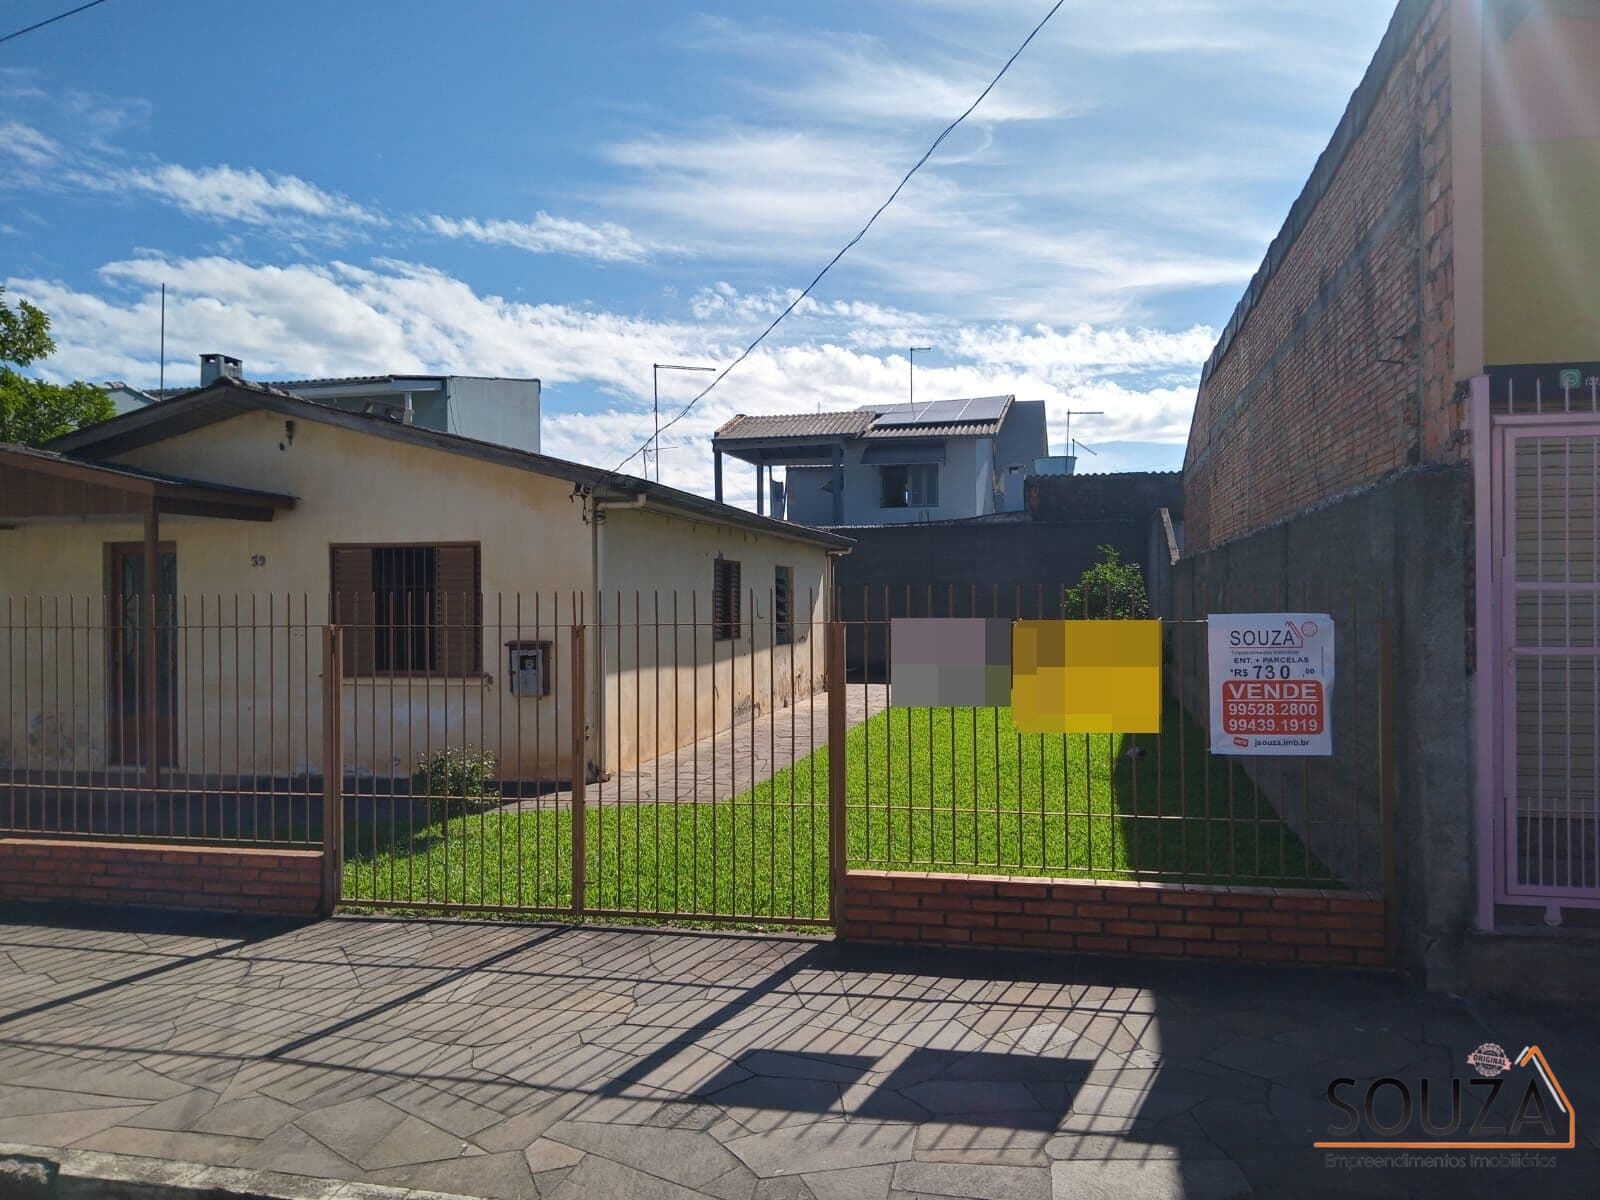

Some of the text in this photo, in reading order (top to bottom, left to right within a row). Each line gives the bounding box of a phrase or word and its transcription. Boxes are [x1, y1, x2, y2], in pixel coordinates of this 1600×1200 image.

[1230, 630, 1295, 646] SOUZA
[1228, 683, 1318, 699] VENDE
[1228, 703, 1317, 716] 99528.2800
[1228, 718, 1318, 731] 99439.1919
[1254, 738, 1310, 747] jsouza.imb.br
